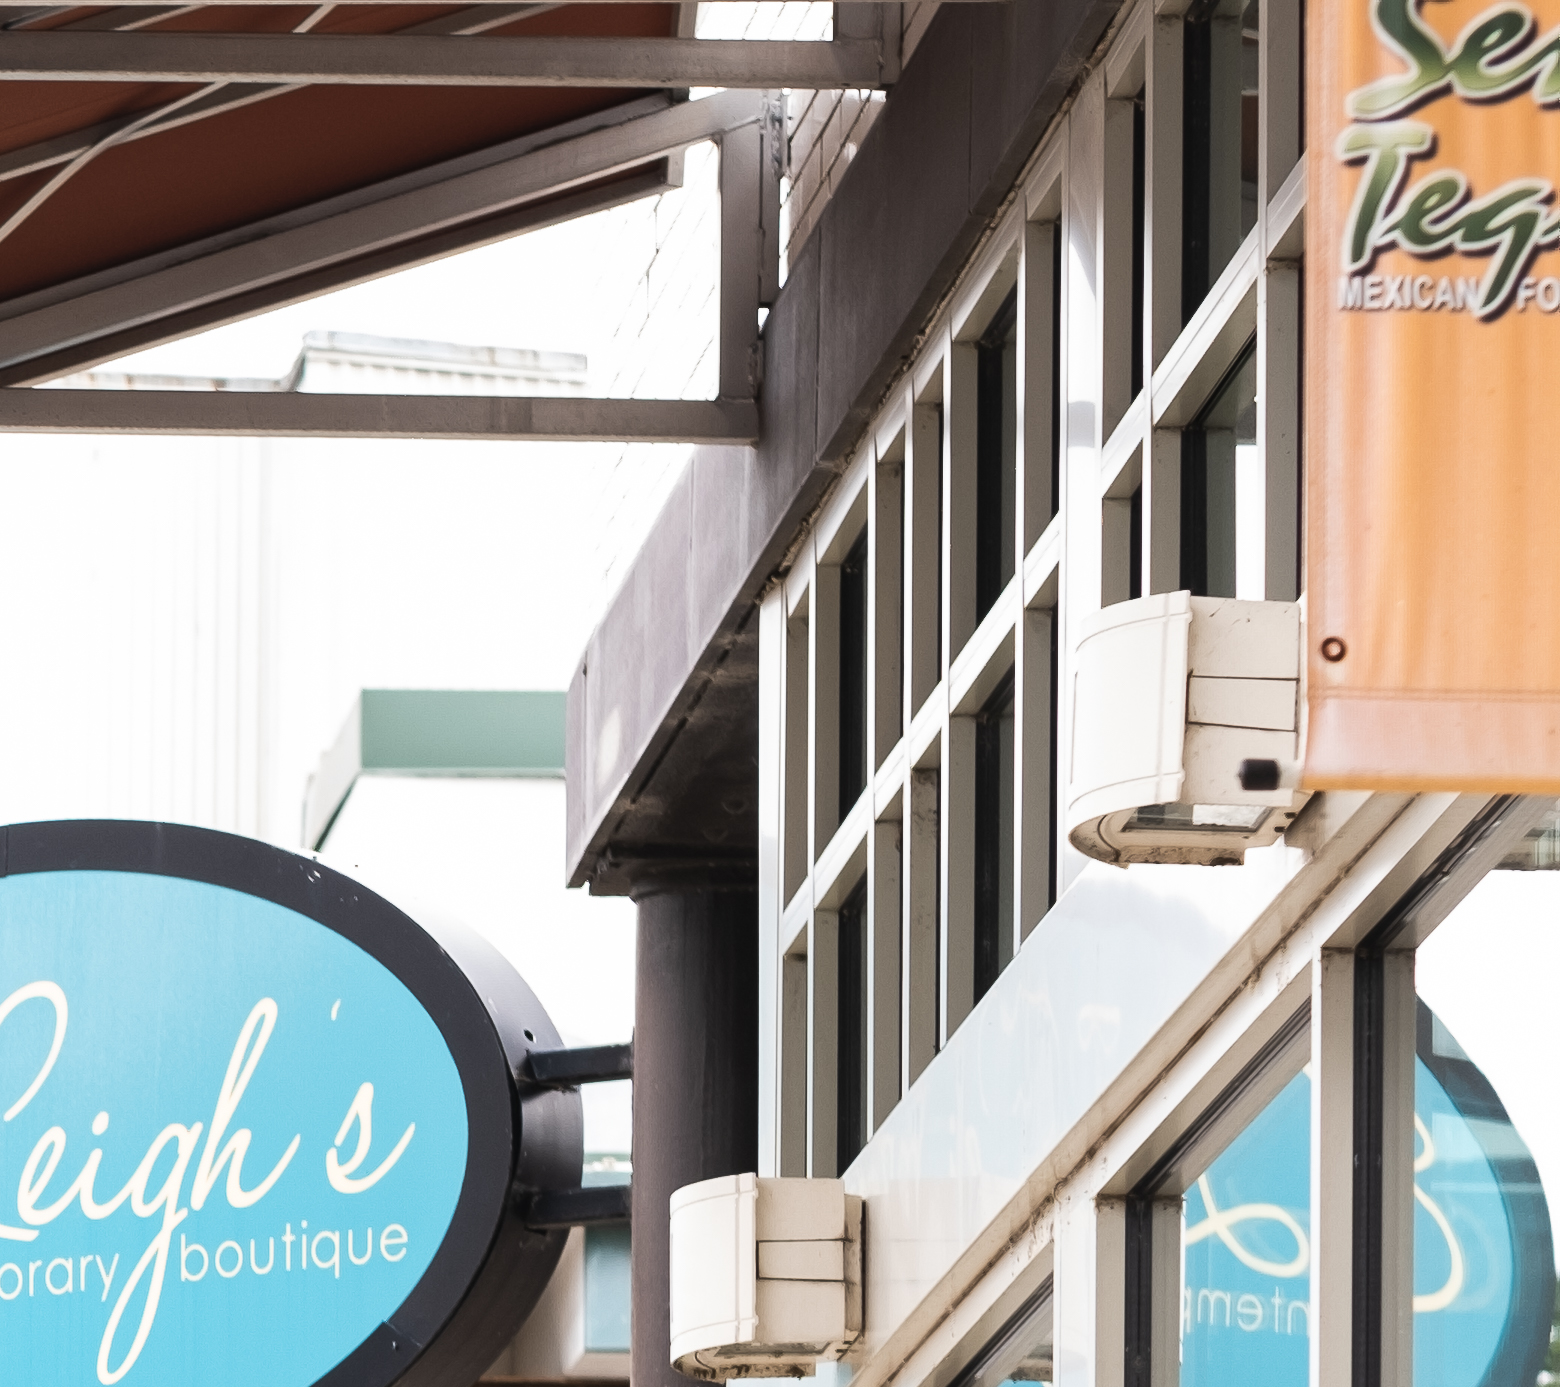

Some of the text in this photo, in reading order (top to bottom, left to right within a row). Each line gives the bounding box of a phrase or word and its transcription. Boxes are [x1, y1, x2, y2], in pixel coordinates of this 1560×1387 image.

[1346, 0, 1560, 120] Se
[1335, 121, 1560, 319] Teq
[1339, 275, 1480, 312] MEXICAN
[180, 1213, 411, 1286] boutique
